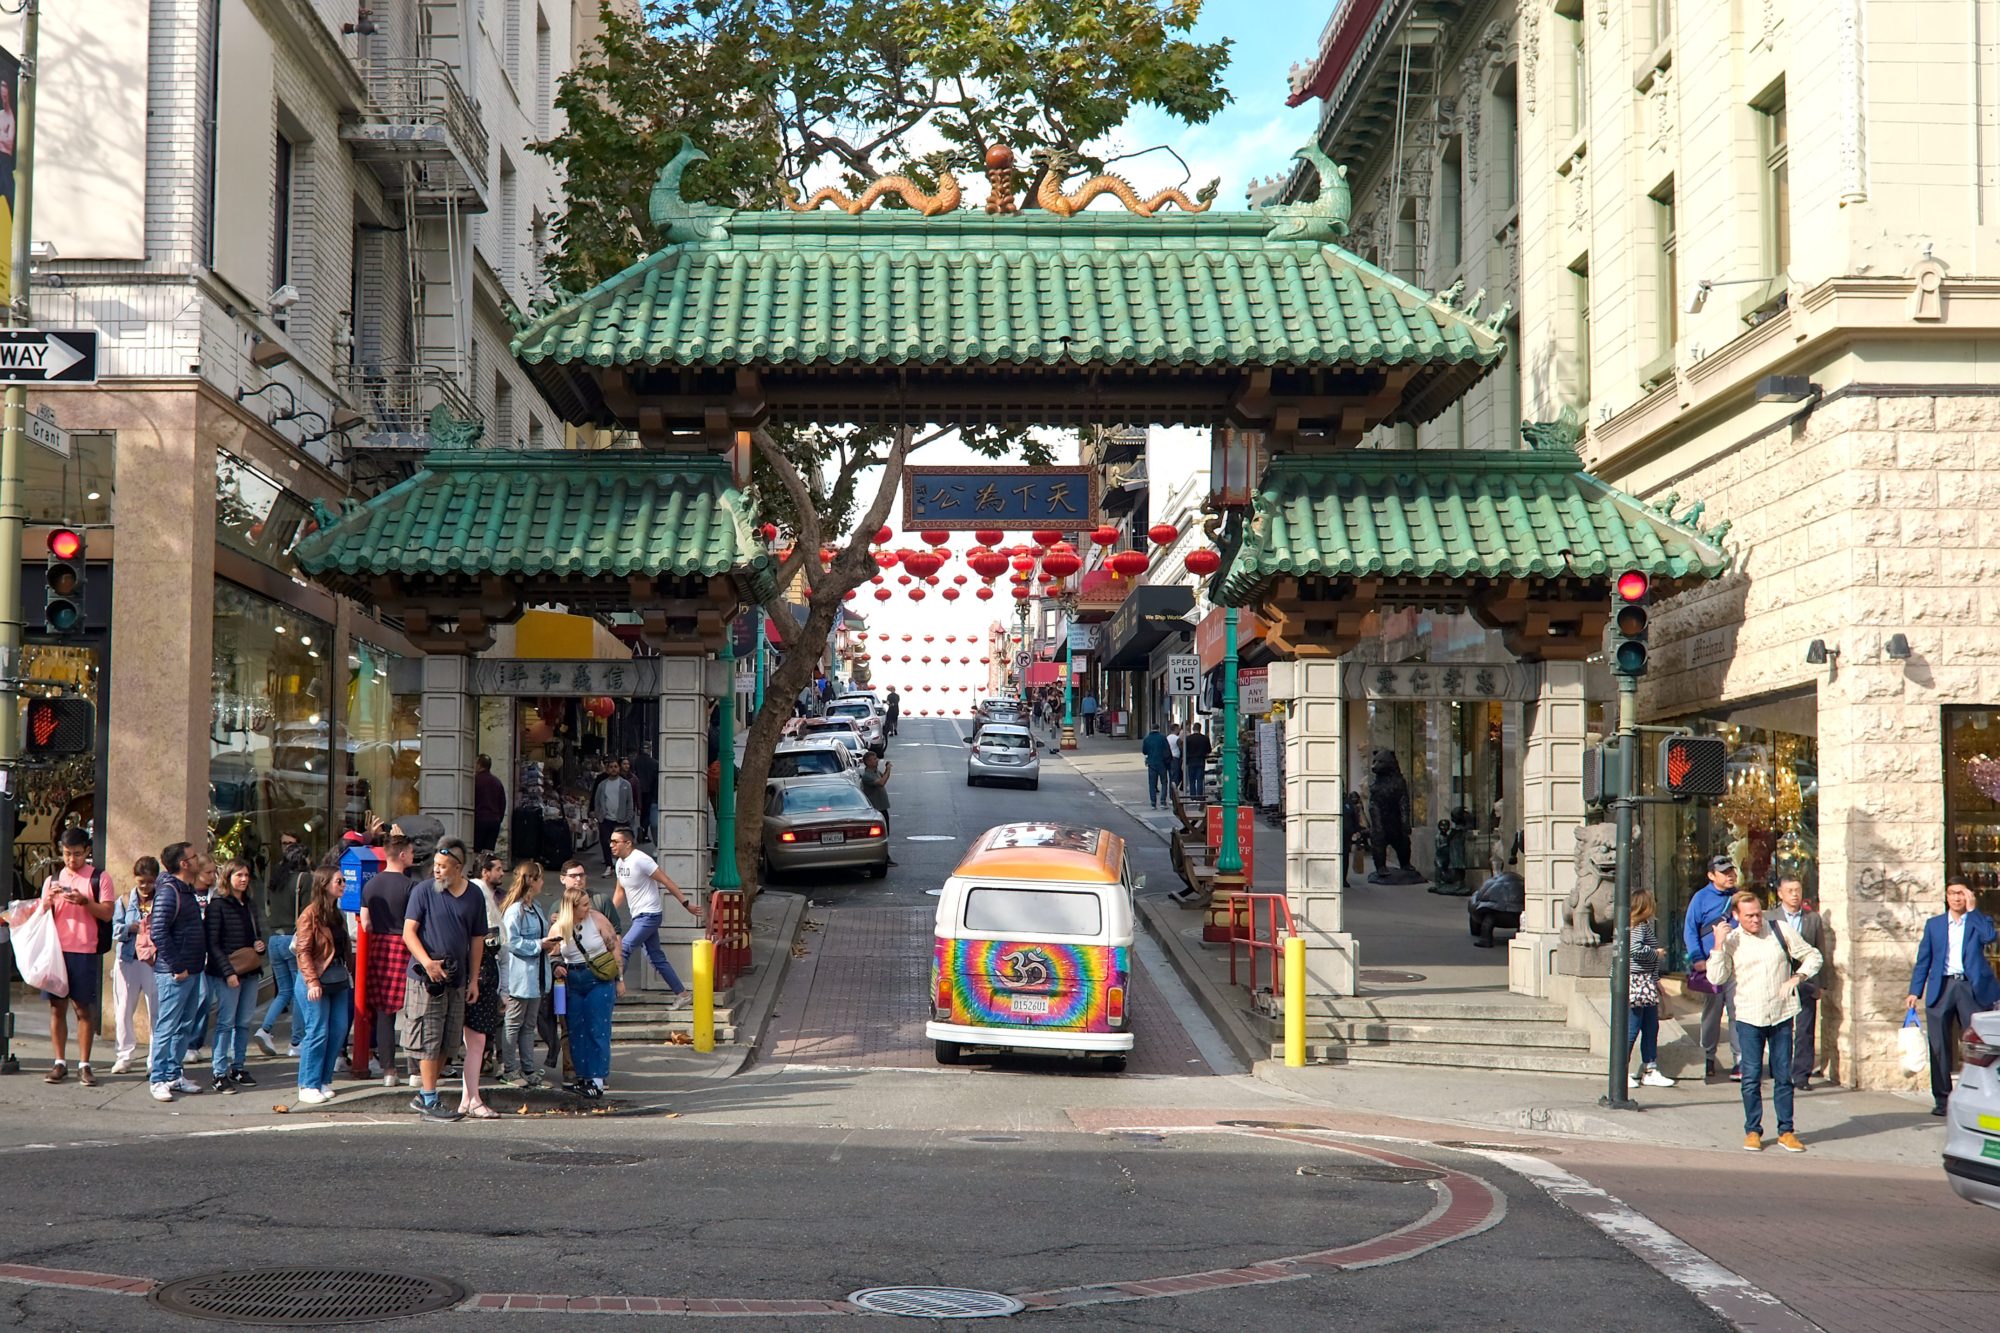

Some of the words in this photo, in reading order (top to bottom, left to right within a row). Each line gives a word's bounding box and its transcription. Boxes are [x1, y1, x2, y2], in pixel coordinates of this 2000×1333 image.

[1, 345, 49, 367] WAY
[33, 421, 60, 447] Grant
[1171, 658, 1199, 666] SPEED
[1175, 676, 1196, 691] 15
[1239, 676, 1250, 686] NO
[1248, 688, 1263, 697] ANY
[1247, 696, 1265, 705] TIME
